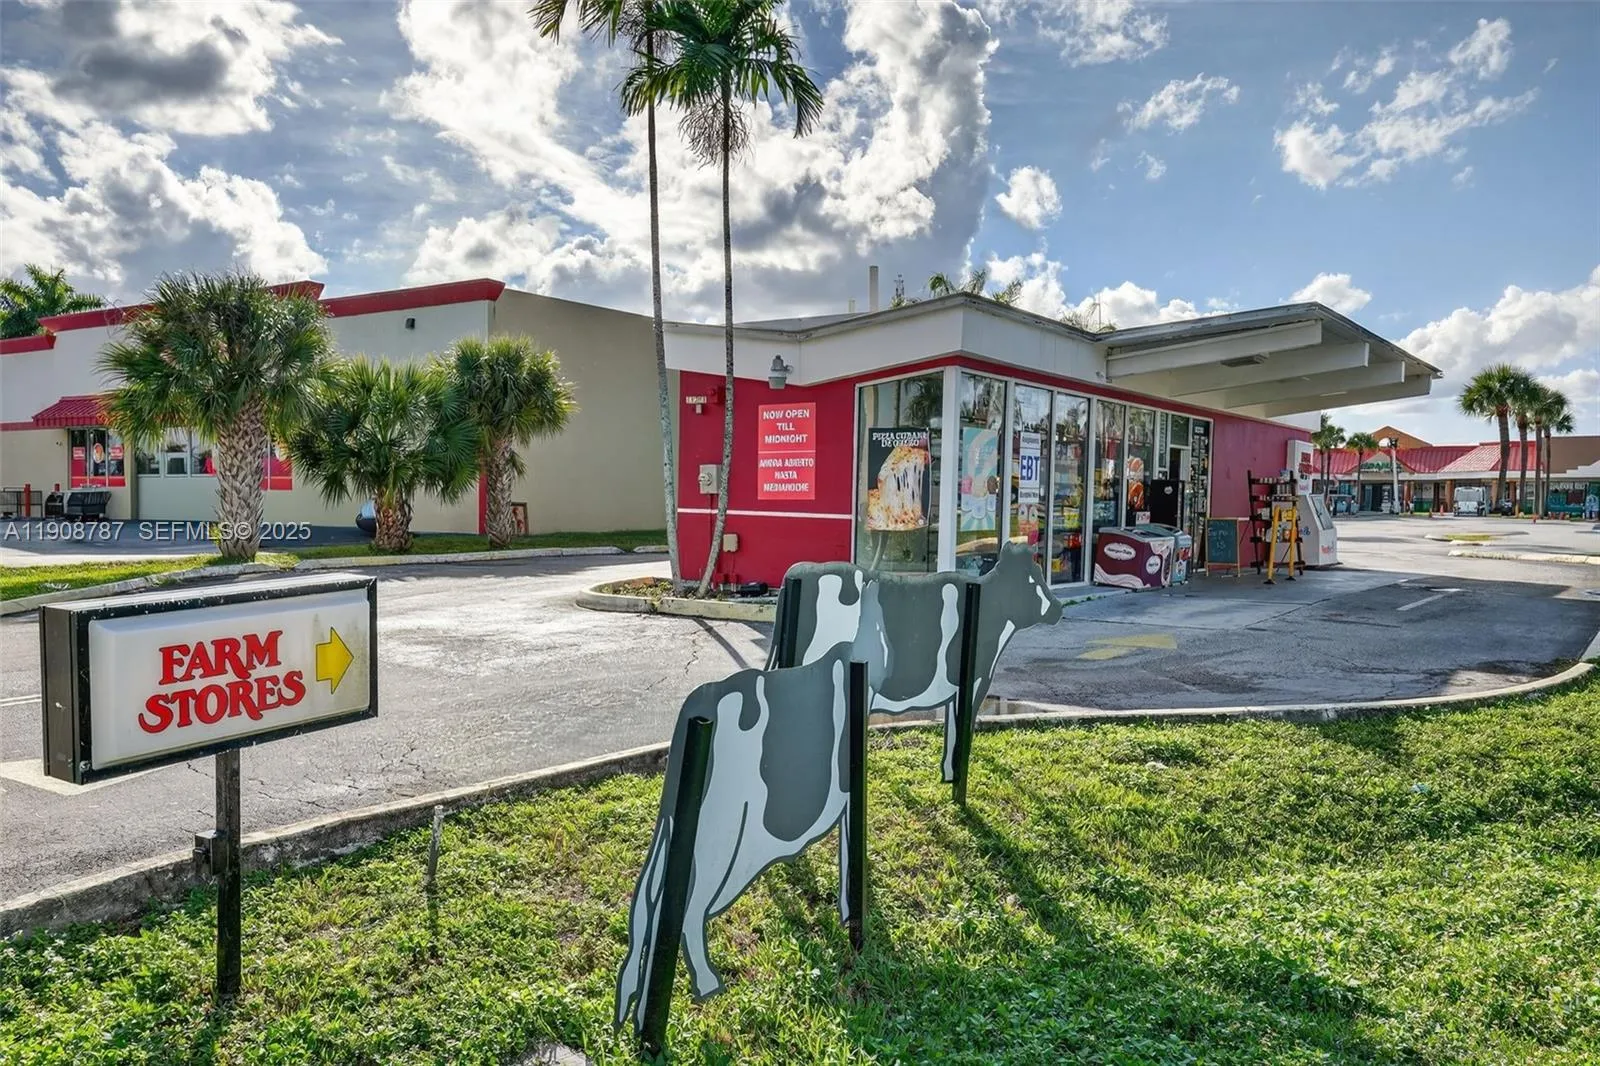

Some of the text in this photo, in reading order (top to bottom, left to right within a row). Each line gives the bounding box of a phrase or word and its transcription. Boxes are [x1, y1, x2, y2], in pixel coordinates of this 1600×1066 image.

[763, 409, 810, 420] NOW OPEN
[776, 422, 795, 431] TILL
[764, 434, 808, 444] MIDNIGHT
[1020, 455, 1040, 480] EBT
[159, 630, 283, 686] FARM
[138, 670, 306, 734] STORES
